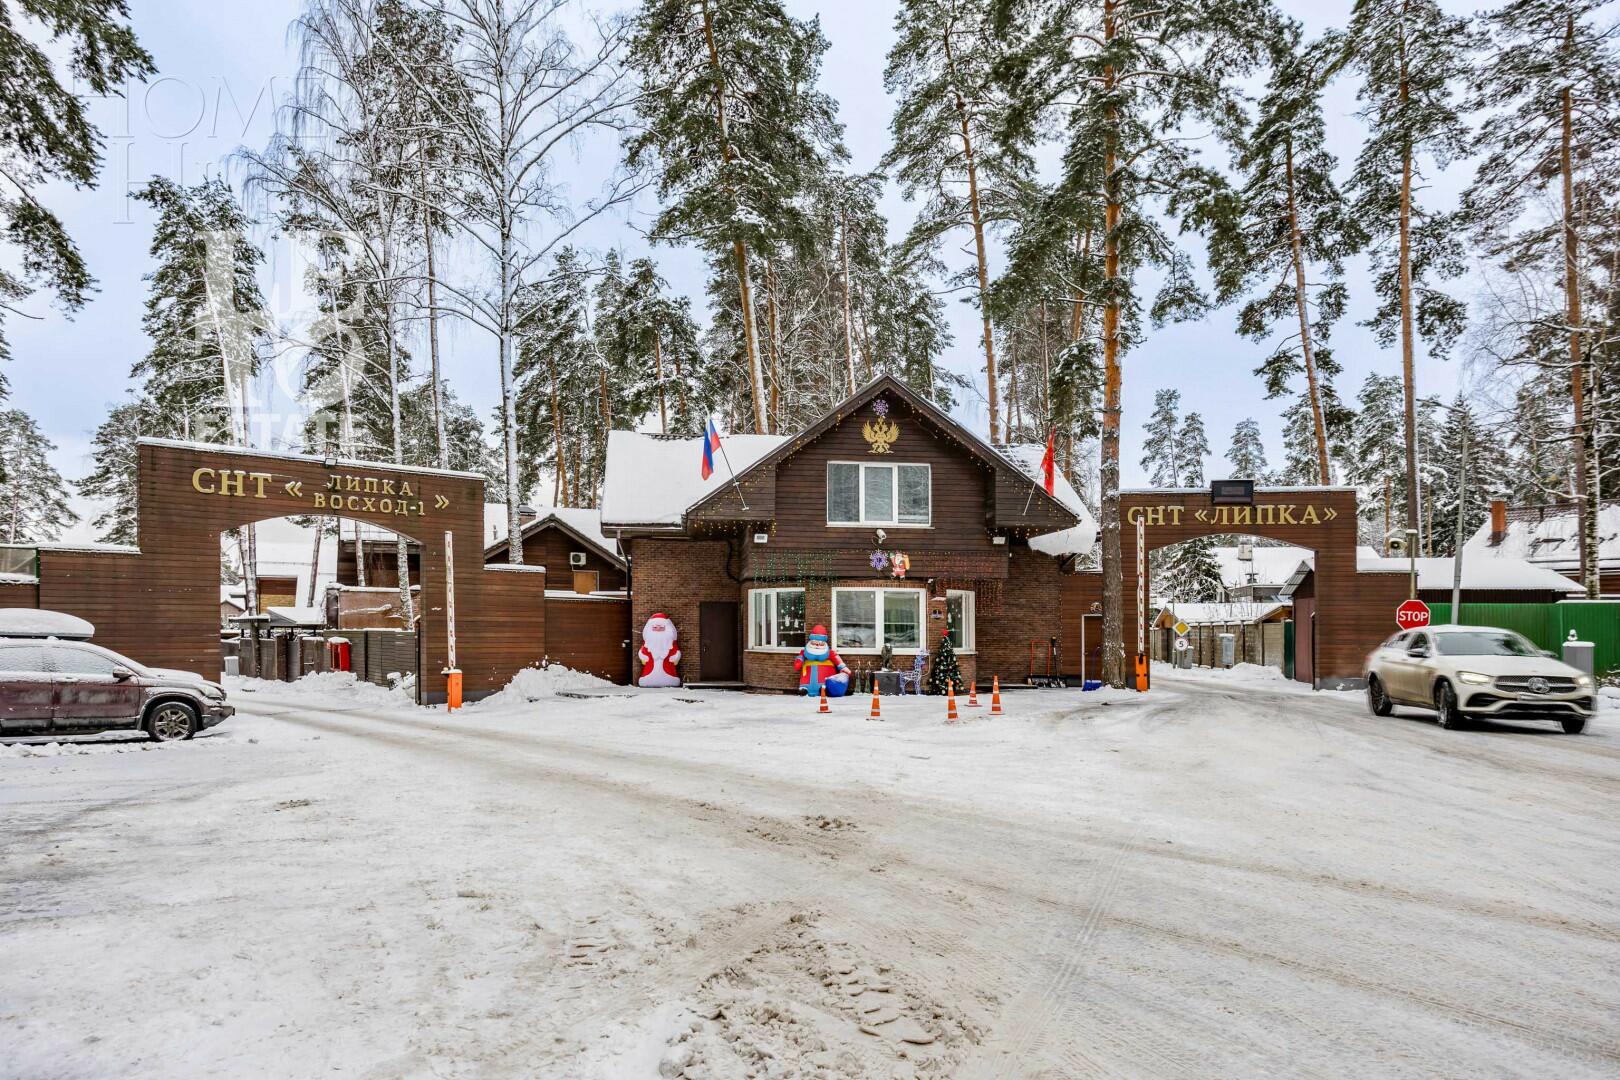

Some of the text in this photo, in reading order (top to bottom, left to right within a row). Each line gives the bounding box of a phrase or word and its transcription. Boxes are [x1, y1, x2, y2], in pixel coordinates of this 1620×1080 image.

[192, 468, 272, 498] СНТ
[326, 474, 414, 497] ЛИПКА
[313, 492, 426, 517] ВОСХОД-1
[1127, 504, 1338, 526] СНТ «ЛИПКА»
[1398, 610, 1429, 622] STOP
[1178, 640, 1184, 648] 5
